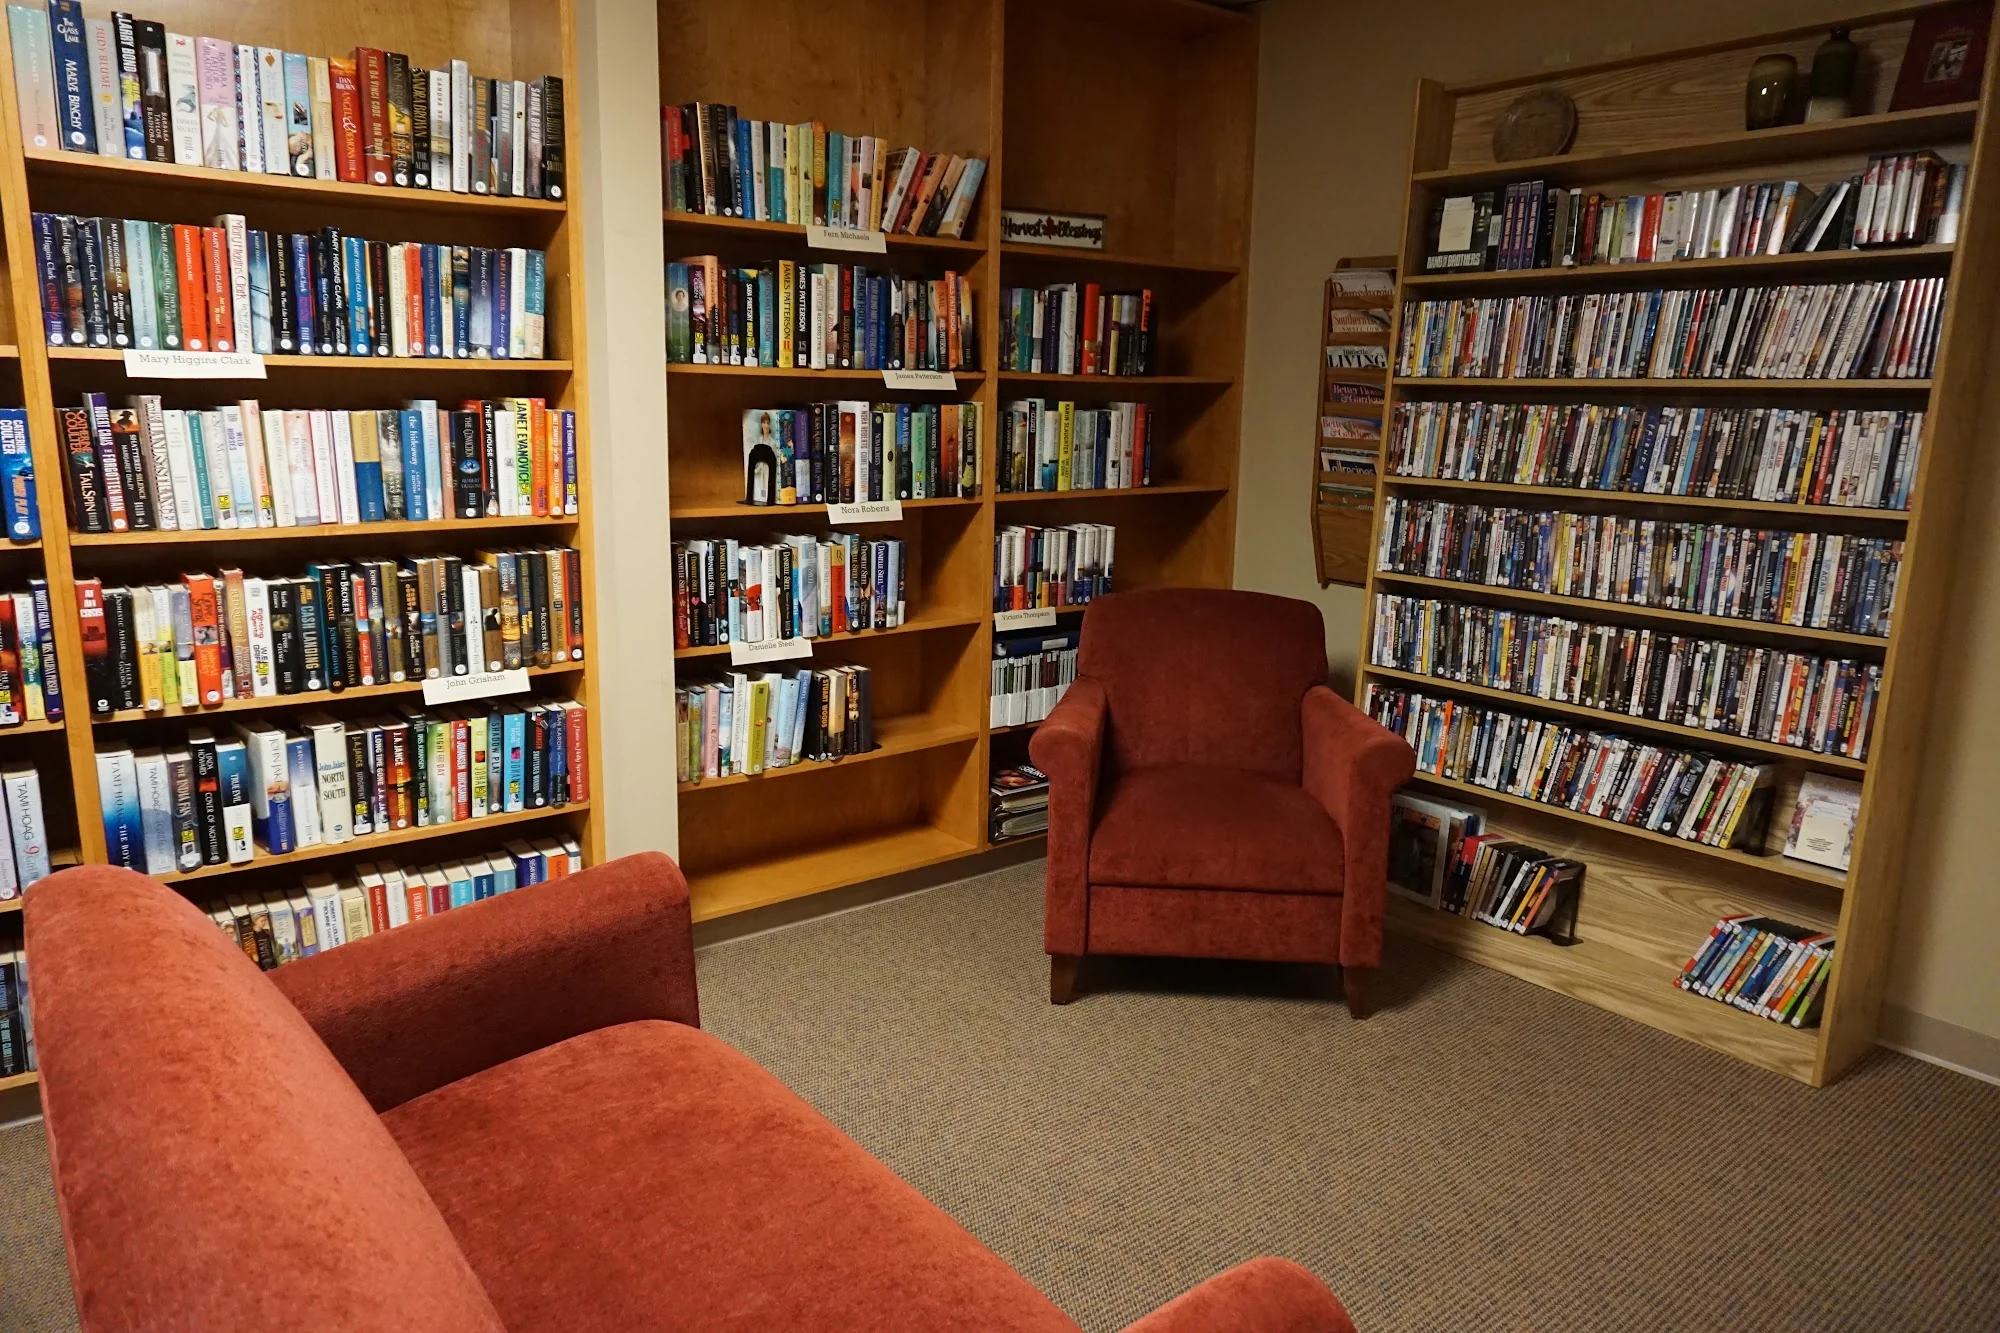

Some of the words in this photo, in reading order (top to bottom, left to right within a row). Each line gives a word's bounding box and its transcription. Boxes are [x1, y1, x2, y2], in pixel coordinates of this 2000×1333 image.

[96, 26, 106, 55] JUDY
[118, 18, 134, 47] LARRY
[122, 48, 137, 72] BOND
[64, 59, 78, 93] MAEVE
[99, 56, 111, 89] BLUME
[68, 95, 82, 130] BINCHY
[824, 230, 839, 238] Fern
[840, 231, 870, 240] Michaels
[46, 262, 56, 280] Clark
[1427, 256, 1443, 268] BAND
[1447, 252, 1481, 266] BROTHERS
[92, 284, 102, 322] ZAPPED
[334, 285, 342, 309] CLARK
[857, 303, 865, 330] HOUSE
[1334, 314, 1368, 326] Southern
[140, 354, 170, 365] Mary
[173, 356, 217, 366] Higgins
[221, 356, 252, 365] Clark
[1328, 354, 1386, 368] LIVING
[1334, 384, 1358, 394] Better
[408, 416, 416, 428] the
[516, 401, 528, 431] JANET
[902, 416, 910, 430] NORA
[0, 420, 16, 455] COULTER
[12, 420, 27, 454] CATHERINE
[66, 412, 82, 455] COULTER
[409, 431, 422, 466] hideaway
[518, 434, 530, 485] EVANOVICH
[102, 455, 122, 497] FORGOTTEN
[80, 471, 95, 512] TAILSPIN
[109, 498, 124, 512] MAN
[840, 506, 860, 514] Nora
[551, 553, 560, 570] JOHN
[500, 562, 508, 591] GRISHAM
[552, 572, 562, 600] GRISHAM
[340, 582, 349, 612] BROKER
[1866, 578, 1877, 602] MILK
[115, 596, 124, 627] DOMESTIC
[326, 586, 334, 620] ASSOCIATE
[300, 605, 316, 628] CASH
[328, 627, 337, 643] JOHN
[778, 640, 794, 648] Steel
[302, 631, 320, 670] LANDING
[1513, 638, 1522, 665] NOAH
[1530, 640, 1538, 676] NON-STOP
[346, 650, 354, 684] GRISHAM
[1634, 657, 1645, 698] PHILOMENA
[447, 679, 467, 690] John
[468, 674, 505, 684] Grisham
[800, 676, 808, 700] SHERRYL
[374, 734, 382, 753] LONG
[394, 732, 402, 744] J.A.
[436, 732, 444, 752] NIGHT
[456, 728, 466, 740] IRIS
[492, 722, 500, 754] SHADOW
[198, 749, 206, 775] HOWARD
[206, 753, 214, 770] LINDA
[270, 740, 280, 762] JOHN
[354, 748, 362, 768] JANCE
[394, 745, 403, 766] JANCE
[457, 740, 467, 770] JOHANSEN
[111, 761, 122, 787] TAMI
[492, 756, 500, 774] PLAY
[176, 778, 190, 800] INDIA
[230, 773, 240, 790] TRUE
[322, 772, 344, 784] NORTH
[355, 772, 365, 800] JUDGMENT
[18, 782, 28, 808] TAMI
[205, 793, 214, 812] COVER
[232, 790, 241, 804] EVIL
[324, 788, 346, 800] SOUTH
[178, 802, 192, 816] FAN
[207, 814, 215, 823] OF
[22, 808, 34, 841] HOAG
[119, 824, 128, 842] THE
[208, 826, 218, 846] NIGHT
[121, 845, 130, 860] BOY
